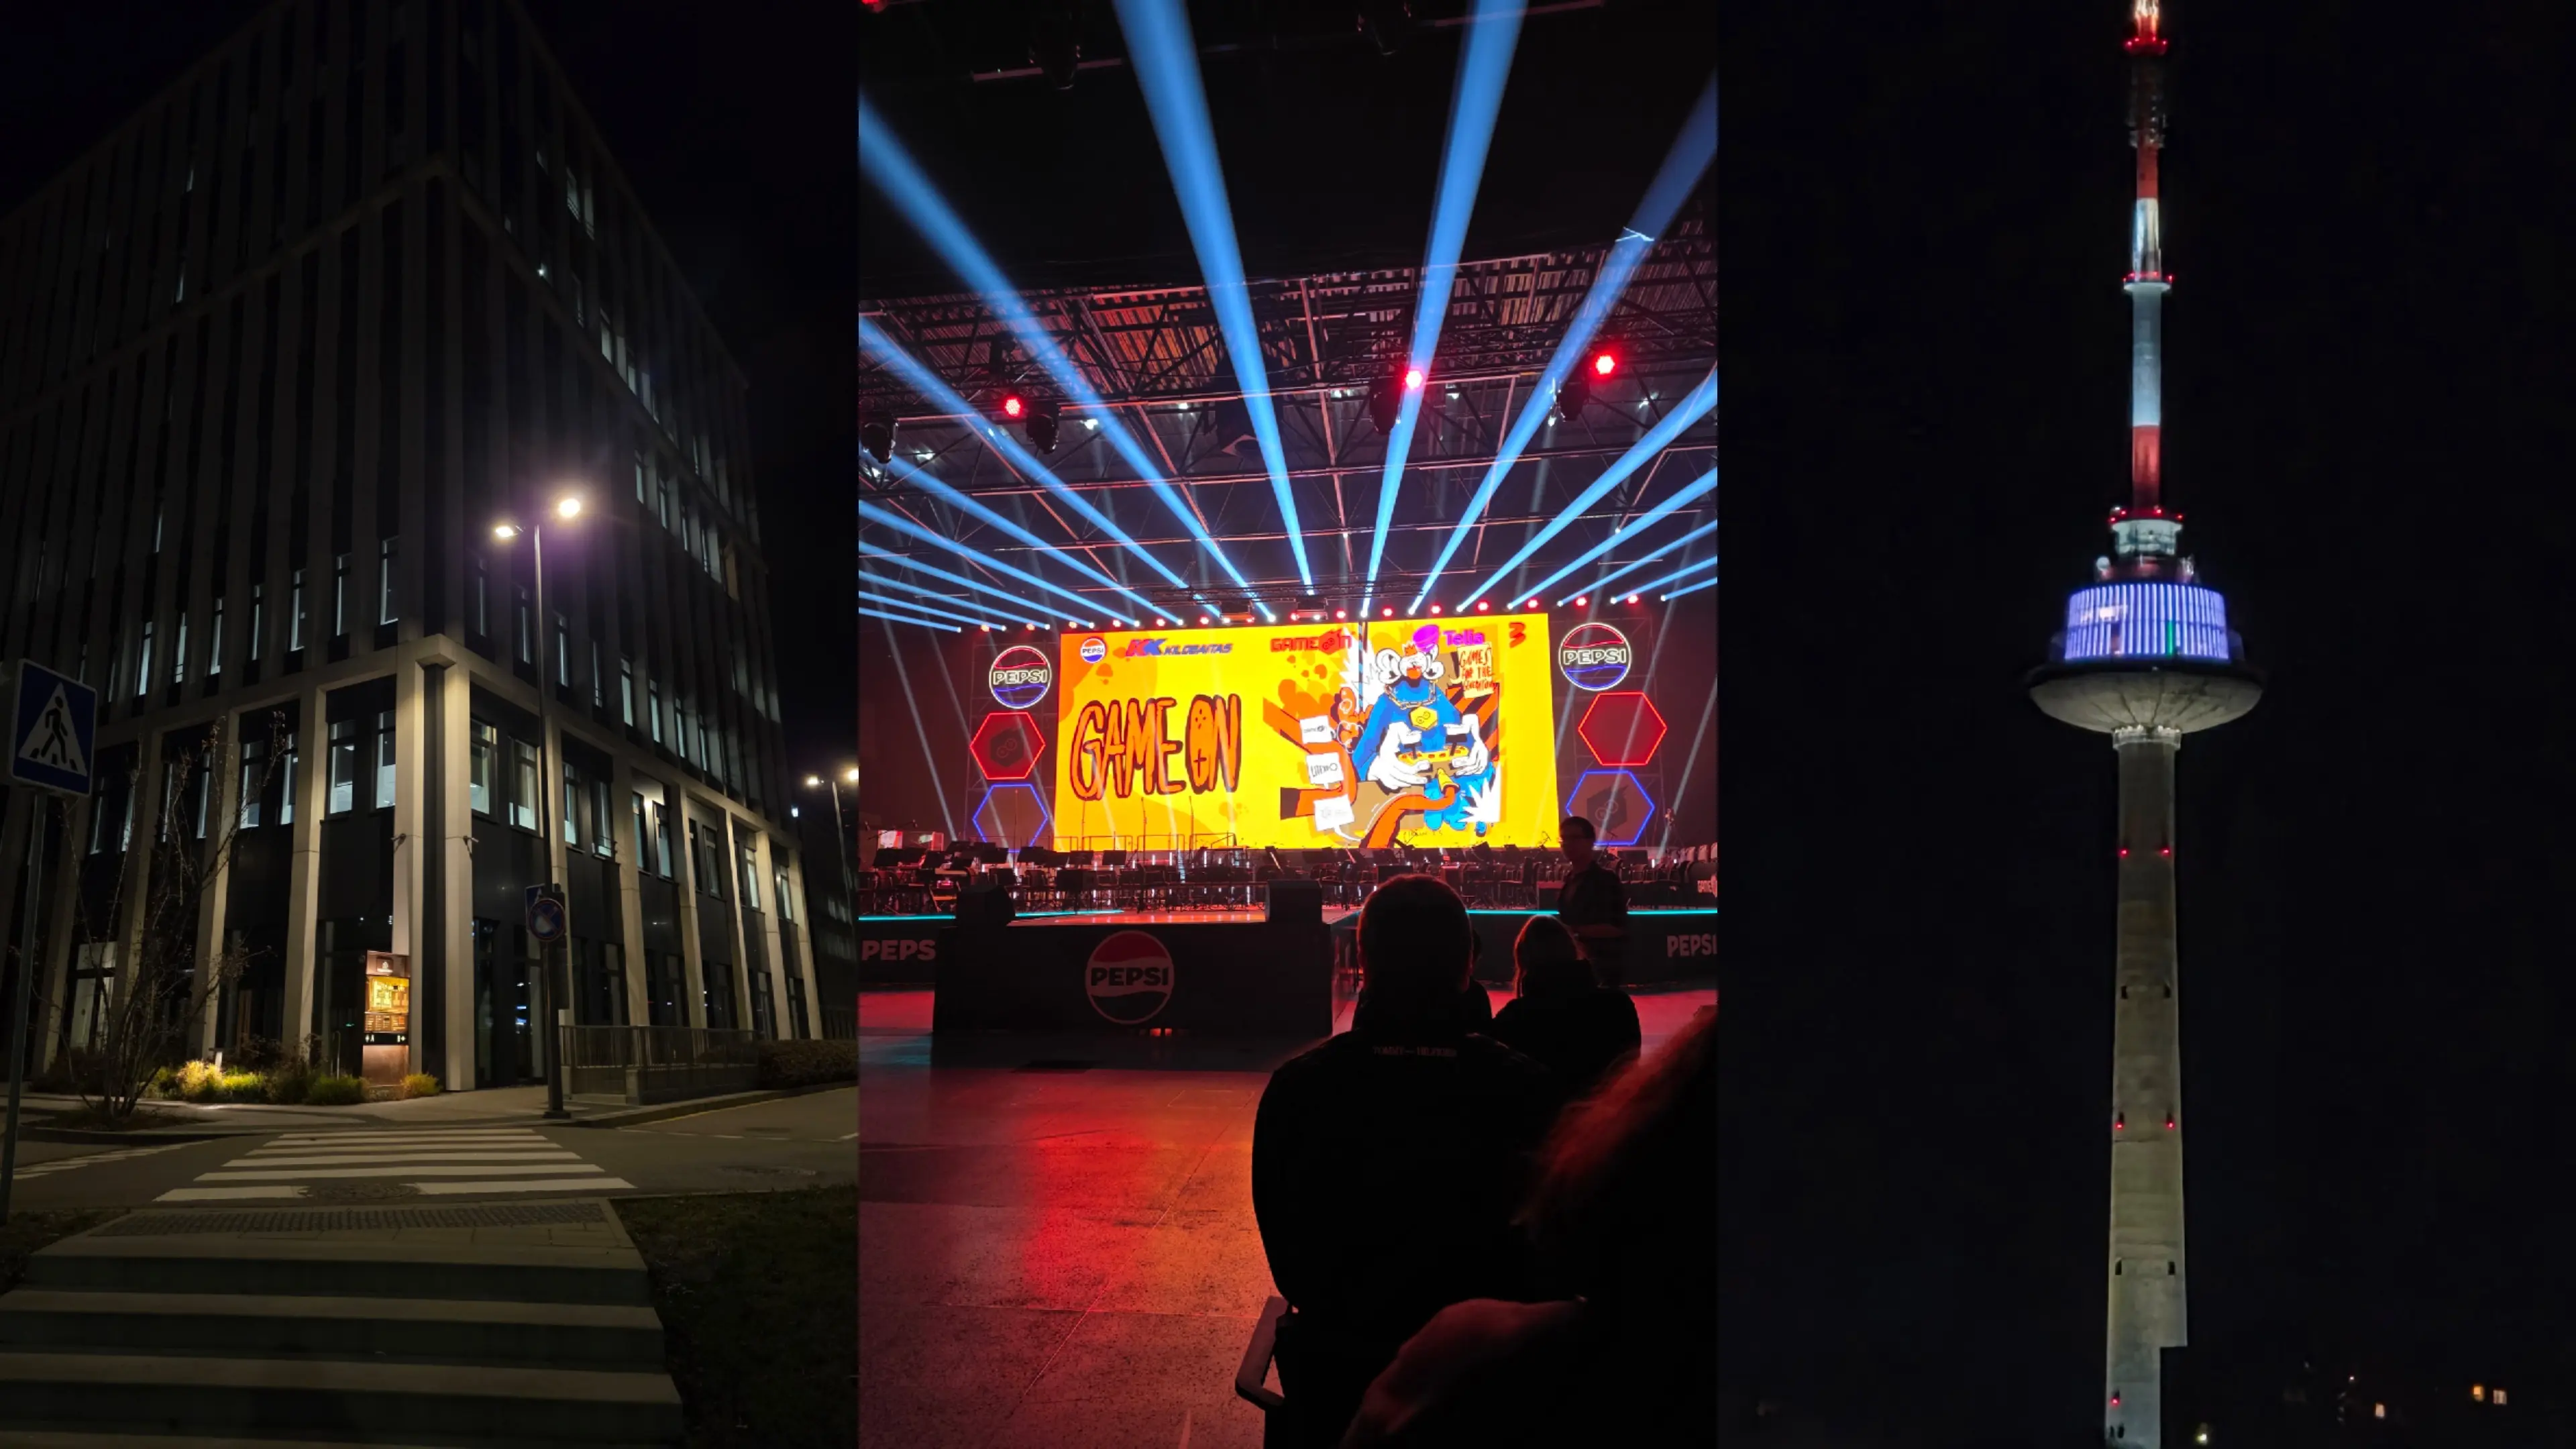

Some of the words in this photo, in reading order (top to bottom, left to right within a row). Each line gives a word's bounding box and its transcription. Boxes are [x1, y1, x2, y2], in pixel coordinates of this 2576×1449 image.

[1444, 629, 1484, 645] Telia
[1562, 649, 1627, 665] PEPSI
[993, 669, 1048, 685] PEPSI
[1477, 665, 1493, 679] THE
[1071, 698, 1186, 800] GAME
[1185, 694, 1241, 794] ON
[1666, 933, 1717, 958] PEPSI
[1091, 967, 1169, 986] PEPSI
